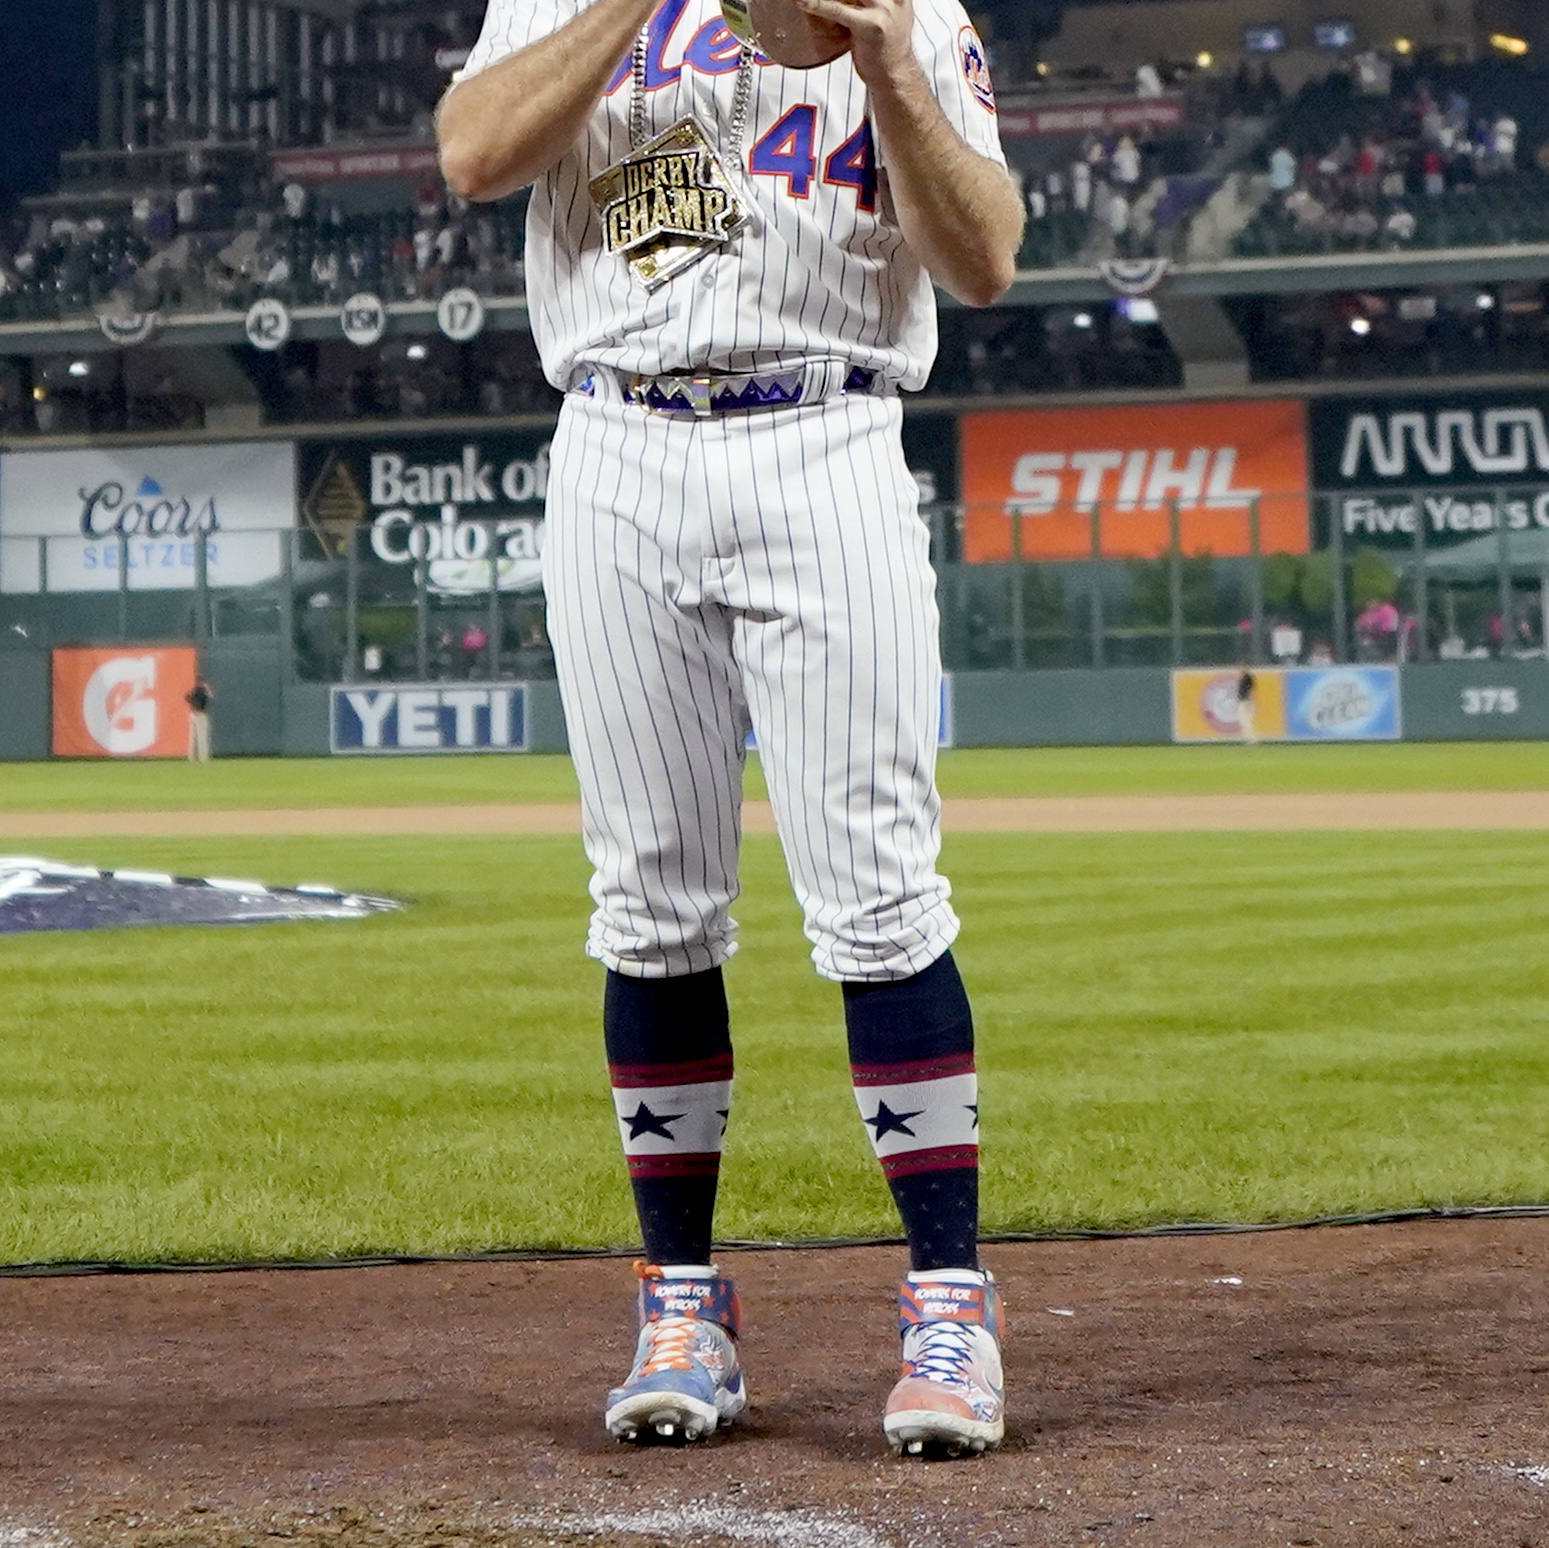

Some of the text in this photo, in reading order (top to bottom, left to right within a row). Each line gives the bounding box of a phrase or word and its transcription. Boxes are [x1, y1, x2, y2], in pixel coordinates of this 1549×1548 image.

[625, 151, 698, 198] DERBY
[748, 102, 879, 214] 44
[608, 185, 728, 252] CHAMP
[371, 444, 495, 505] Bank
[1005, 447, 1262, 516] STIHL
[78, 480, 220, 541] Coors
[371, 504, 546, 564] Coloa
[1343, 498, 1416, 533] Five
[82, 652, 157, 754] G
[345, 689, 509, 748] YETI
[1460, 686, 1519, 716] 375
